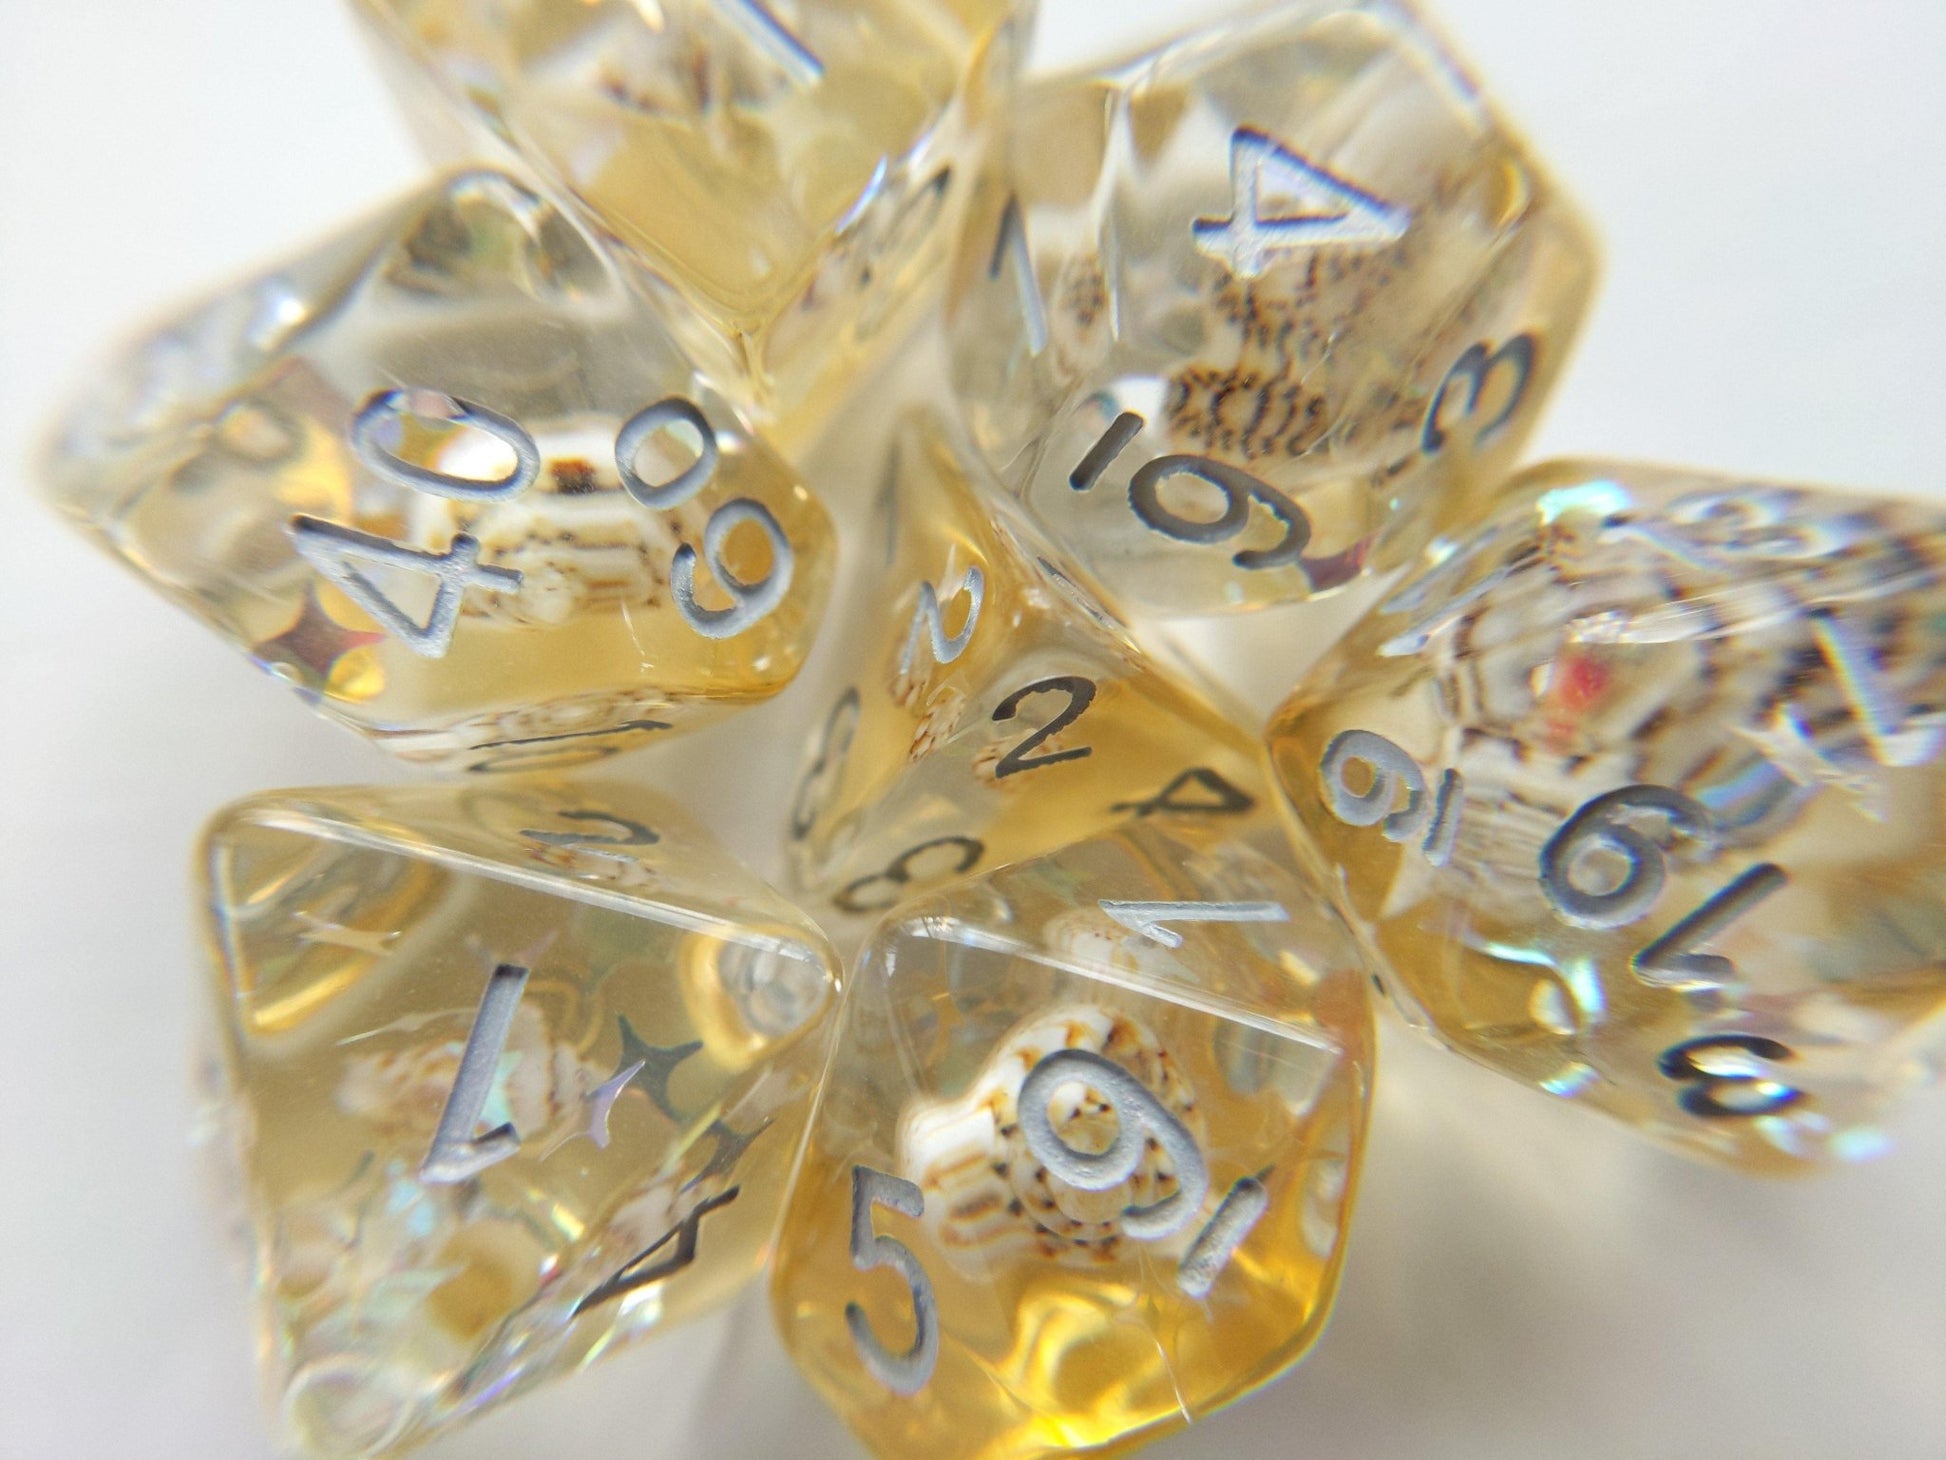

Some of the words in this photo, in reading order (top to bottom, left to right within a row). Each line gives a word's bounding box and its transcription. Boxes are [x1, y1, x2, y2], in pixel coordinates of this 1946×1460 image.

[1193, 124, 1410, 278] 4
[1421, 332, 1536, 456] 3
[992, 676, 1097, 778] 2
[1111, 766, 1256, 818] 4
[567, 1184, 741, 1320] 4
[844, 1164, 940, 1397] 5
